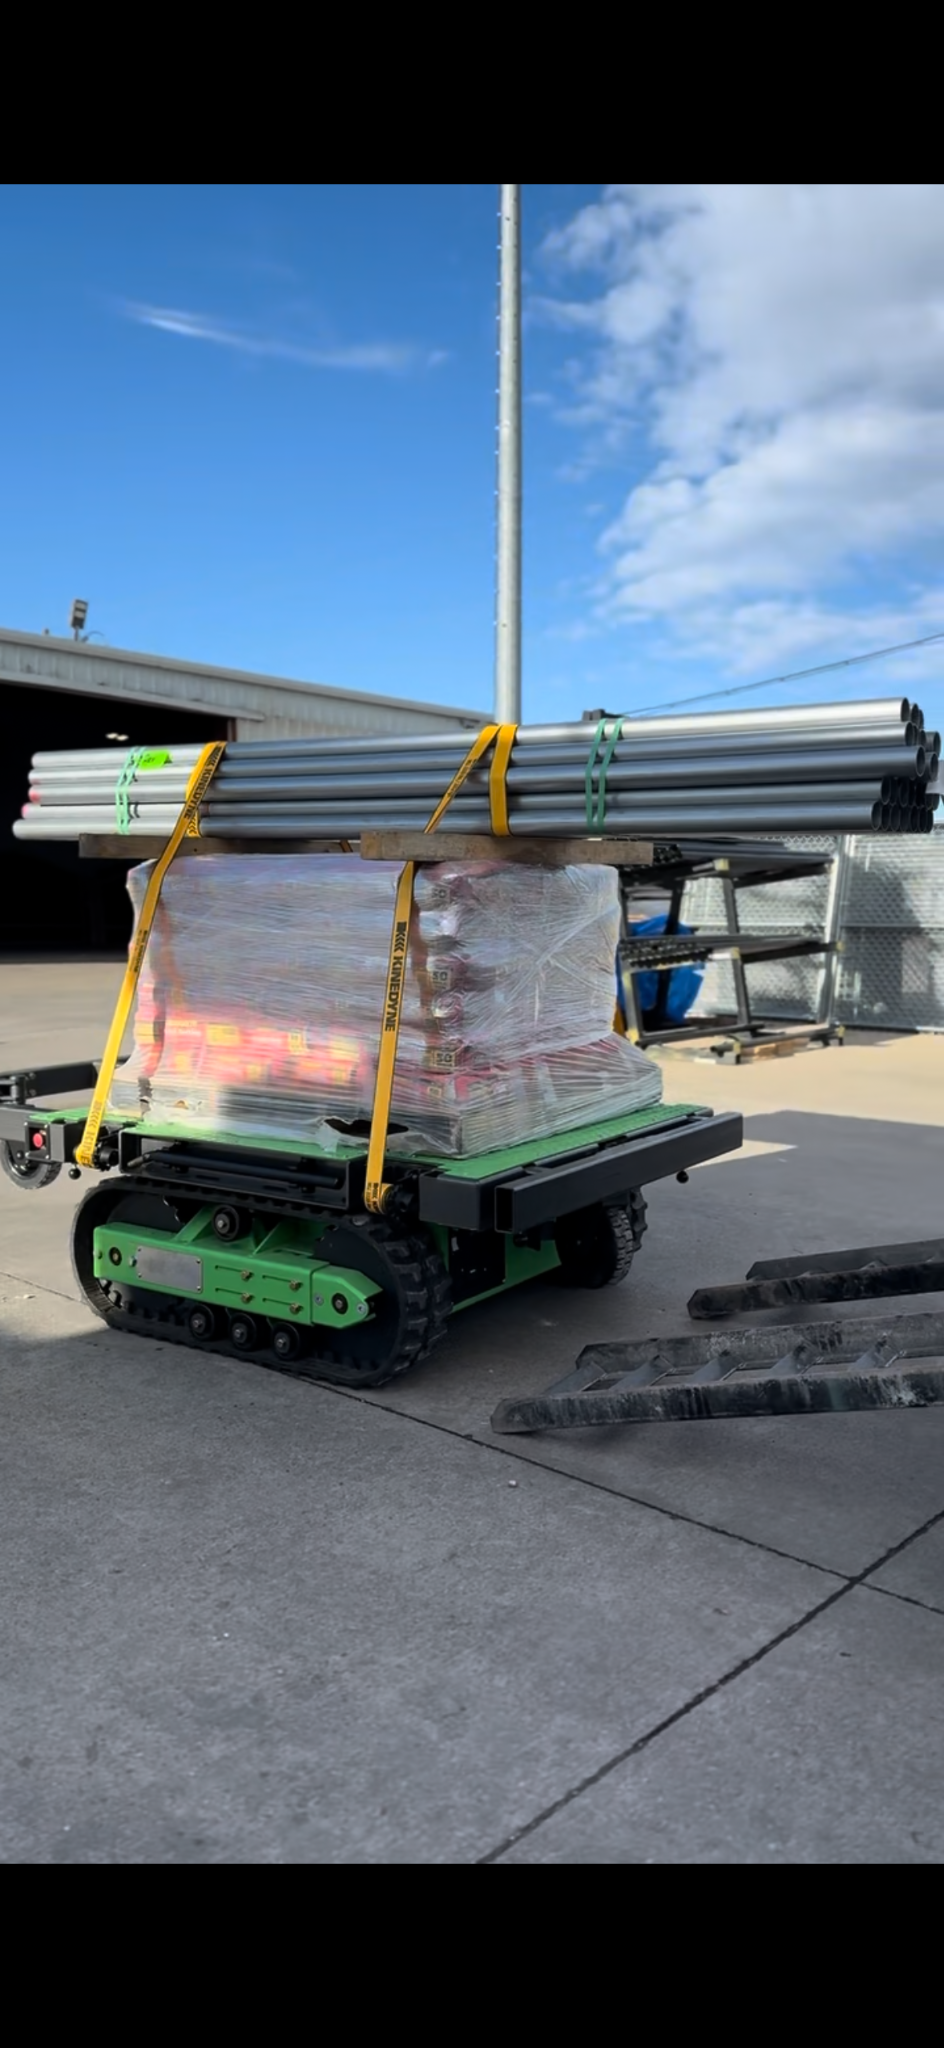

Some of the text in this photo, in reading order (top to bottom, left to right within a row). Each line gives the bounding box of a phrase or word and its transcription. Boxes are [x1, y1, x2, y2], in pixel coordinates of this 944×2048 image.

[184, 766, 214, 820] KINEDYNE
[385, 956, 404, 1032] KINEDYNE
[432, 971, 448, 981] 50
[80, 1131, 96, 1166] KINE
